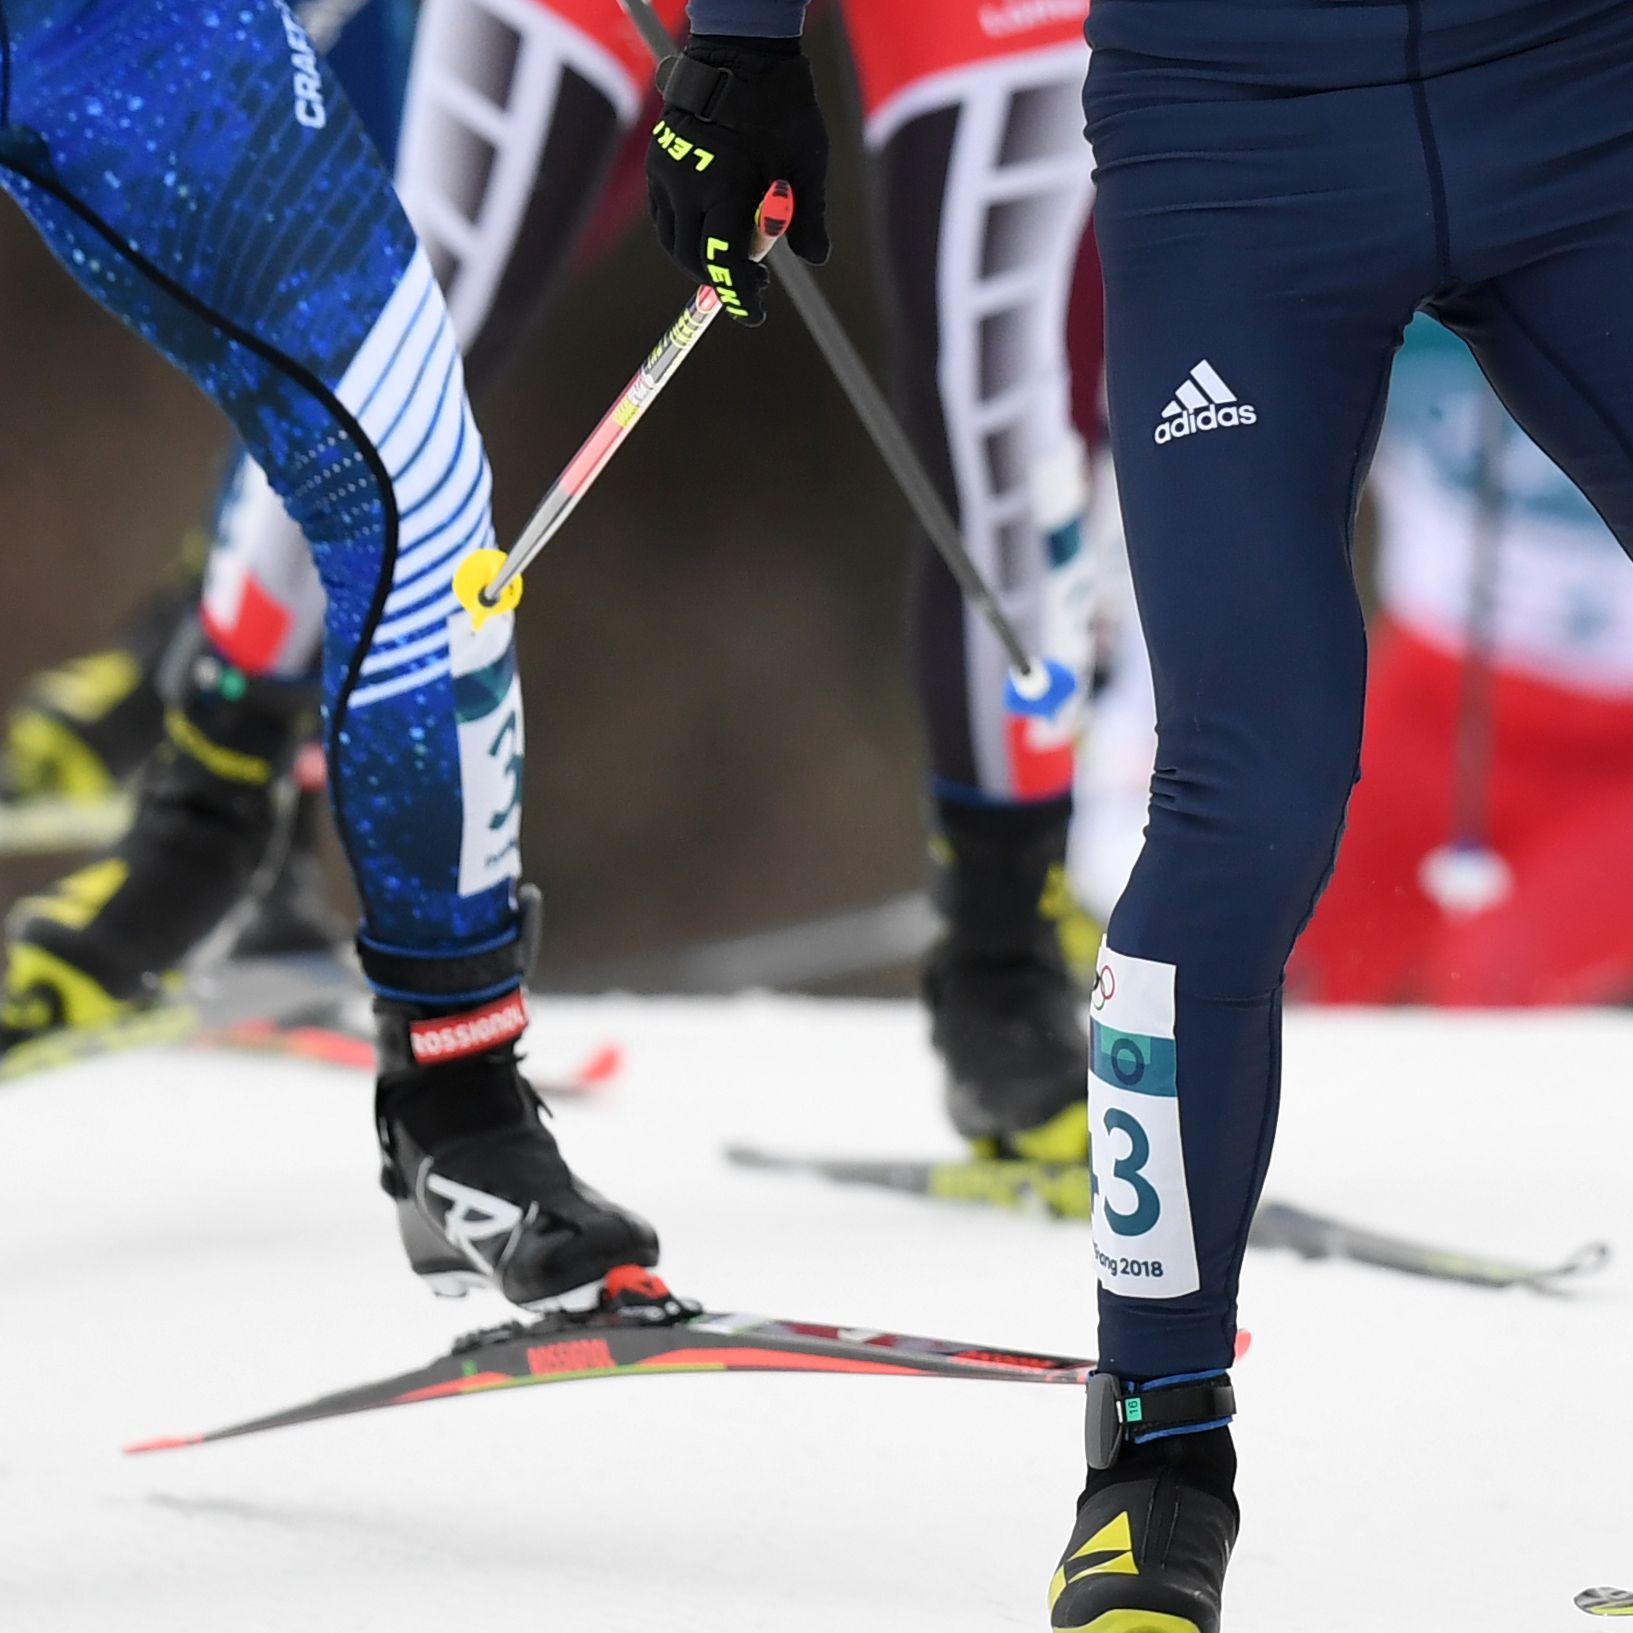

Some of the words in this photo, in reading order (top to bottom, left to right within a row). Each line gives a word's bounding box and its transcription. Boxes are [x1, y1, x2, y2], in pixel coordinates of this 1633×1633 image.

[652, 120, 715, 172] LEKI
[706, 236, 749, 317] LEKI
[1154, 403, 1257, 445] adidas
[1120, 1257, 1164, 1278] 2018
[1128, 1400, 1139, 1415] 16
